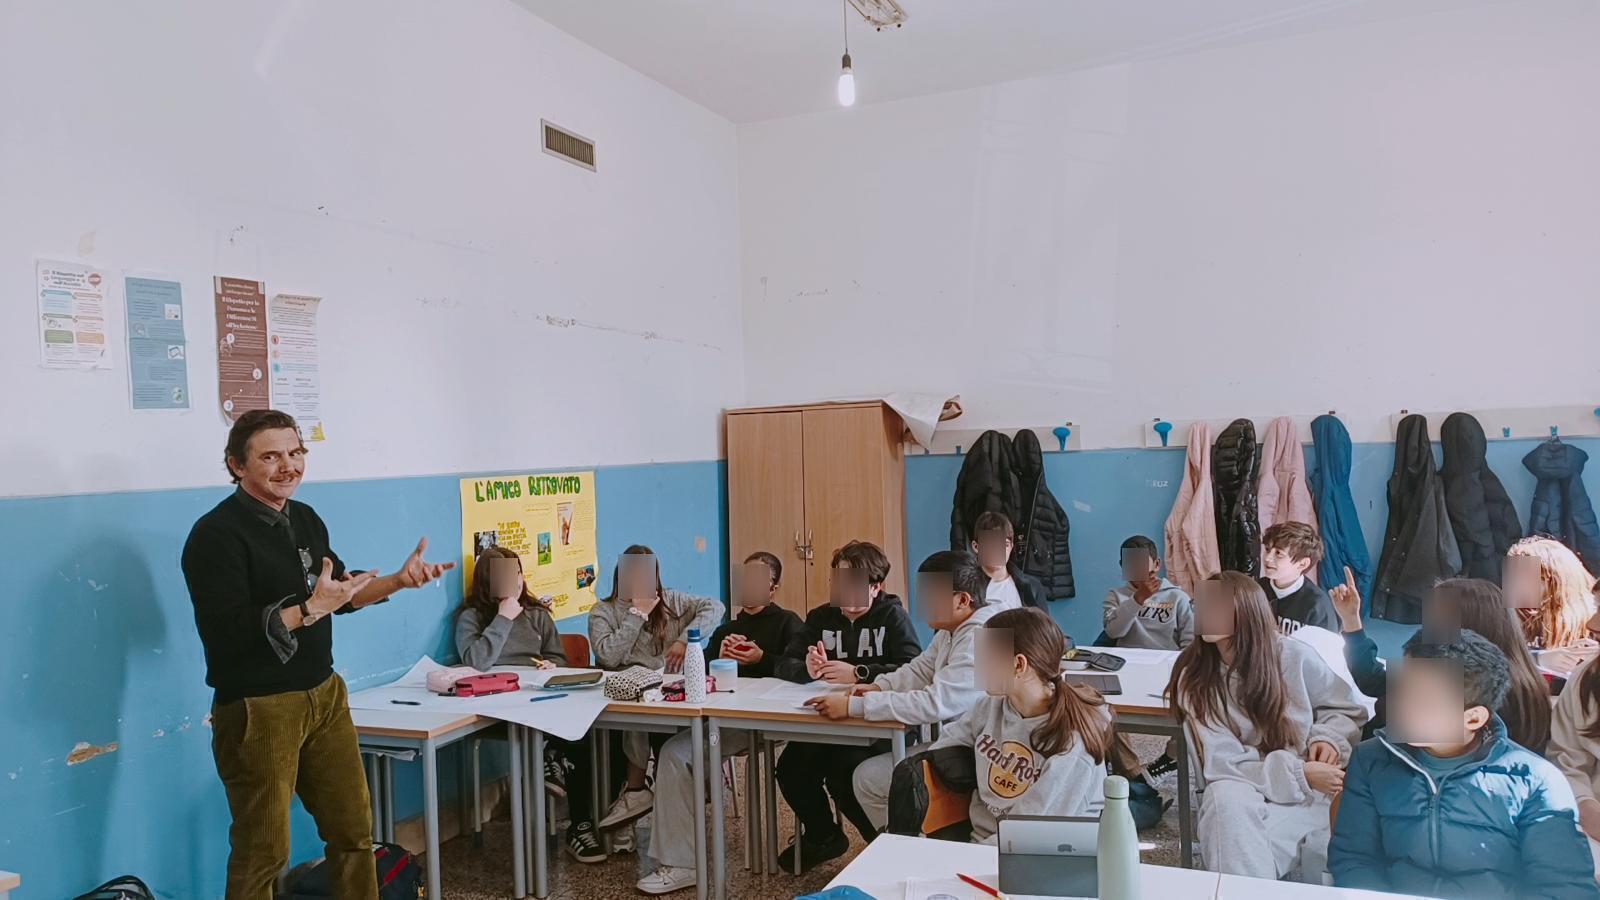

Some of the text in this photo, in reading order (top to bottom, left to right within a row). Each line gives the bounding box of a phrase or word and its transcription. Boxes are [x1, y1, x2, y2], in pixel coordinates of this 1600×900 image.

[474, 476, 581, 503] L'AMICO RITROVATO
[822, 626, 886, 659] PLAY
[977, 734, 1015, 769] Hard
[993, 775, 1018, 792] CAFE
